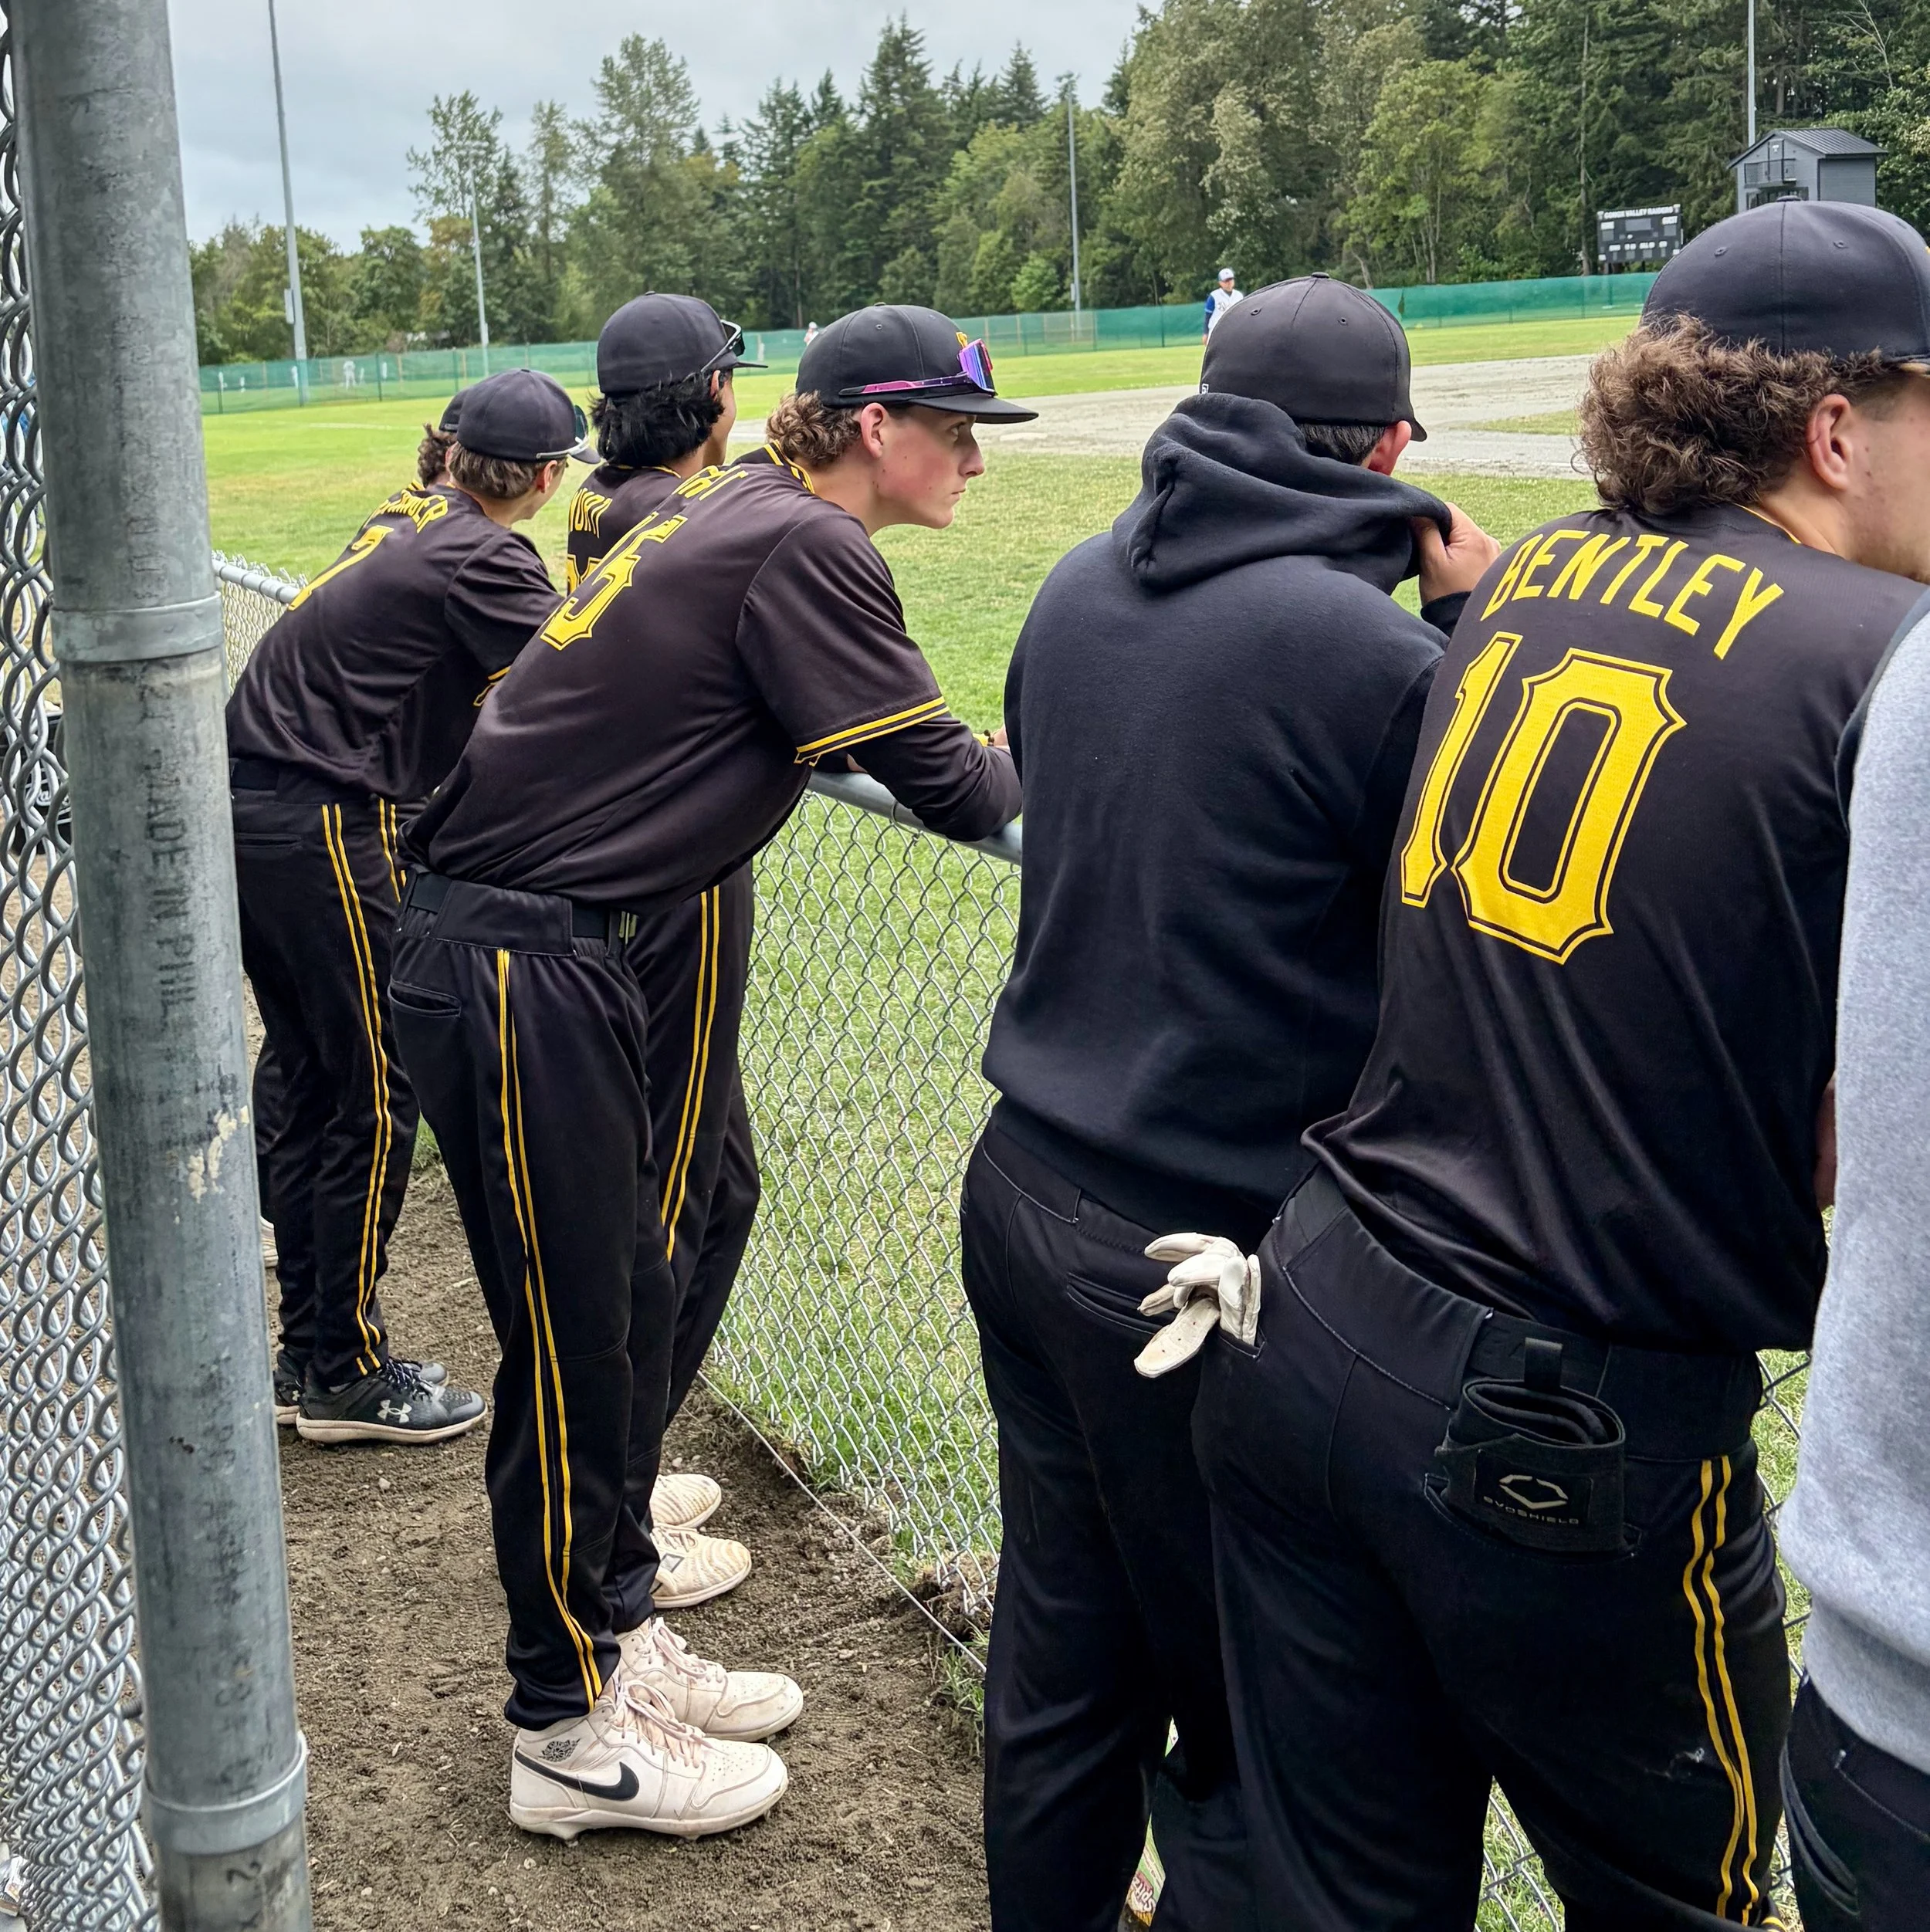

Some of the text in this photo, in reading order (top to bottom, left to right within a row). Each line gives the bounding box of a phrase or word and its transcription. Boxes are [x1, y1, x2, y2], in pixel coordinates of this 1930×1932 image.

[1480, 529, 1784, 661] BENTLEY
[1400, 631, 1688, 966] 10
[1483, 1496, 1580, 1524] EVOSHIELD
